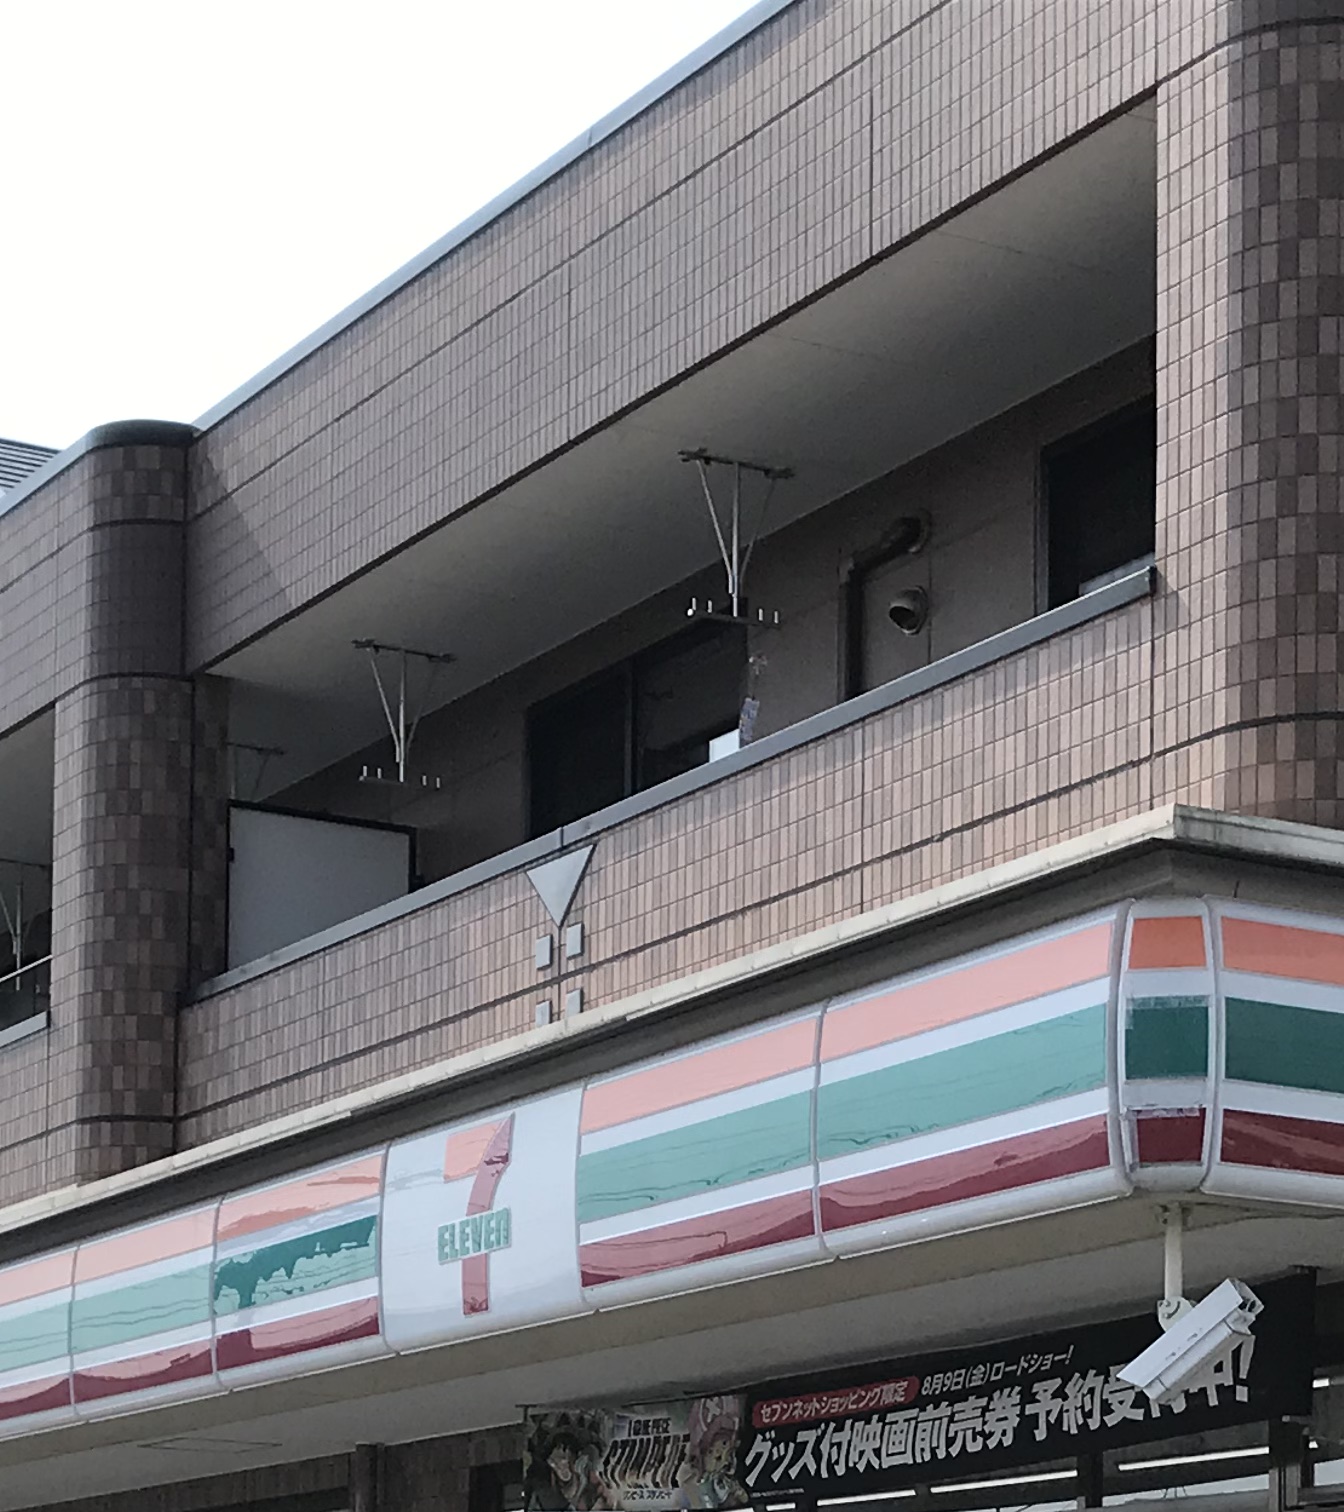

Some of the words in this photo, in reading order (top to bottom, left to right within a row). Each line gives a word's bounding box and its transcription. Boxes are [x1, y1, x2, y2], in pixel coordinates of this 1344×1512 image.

[744, 1385, 1022, 1488] グッズ付映画前売券
[1024, 1334, 1256, 1442] 予約受中!
[761, 1380, 908, 1423] セブンネットショッピング限定
